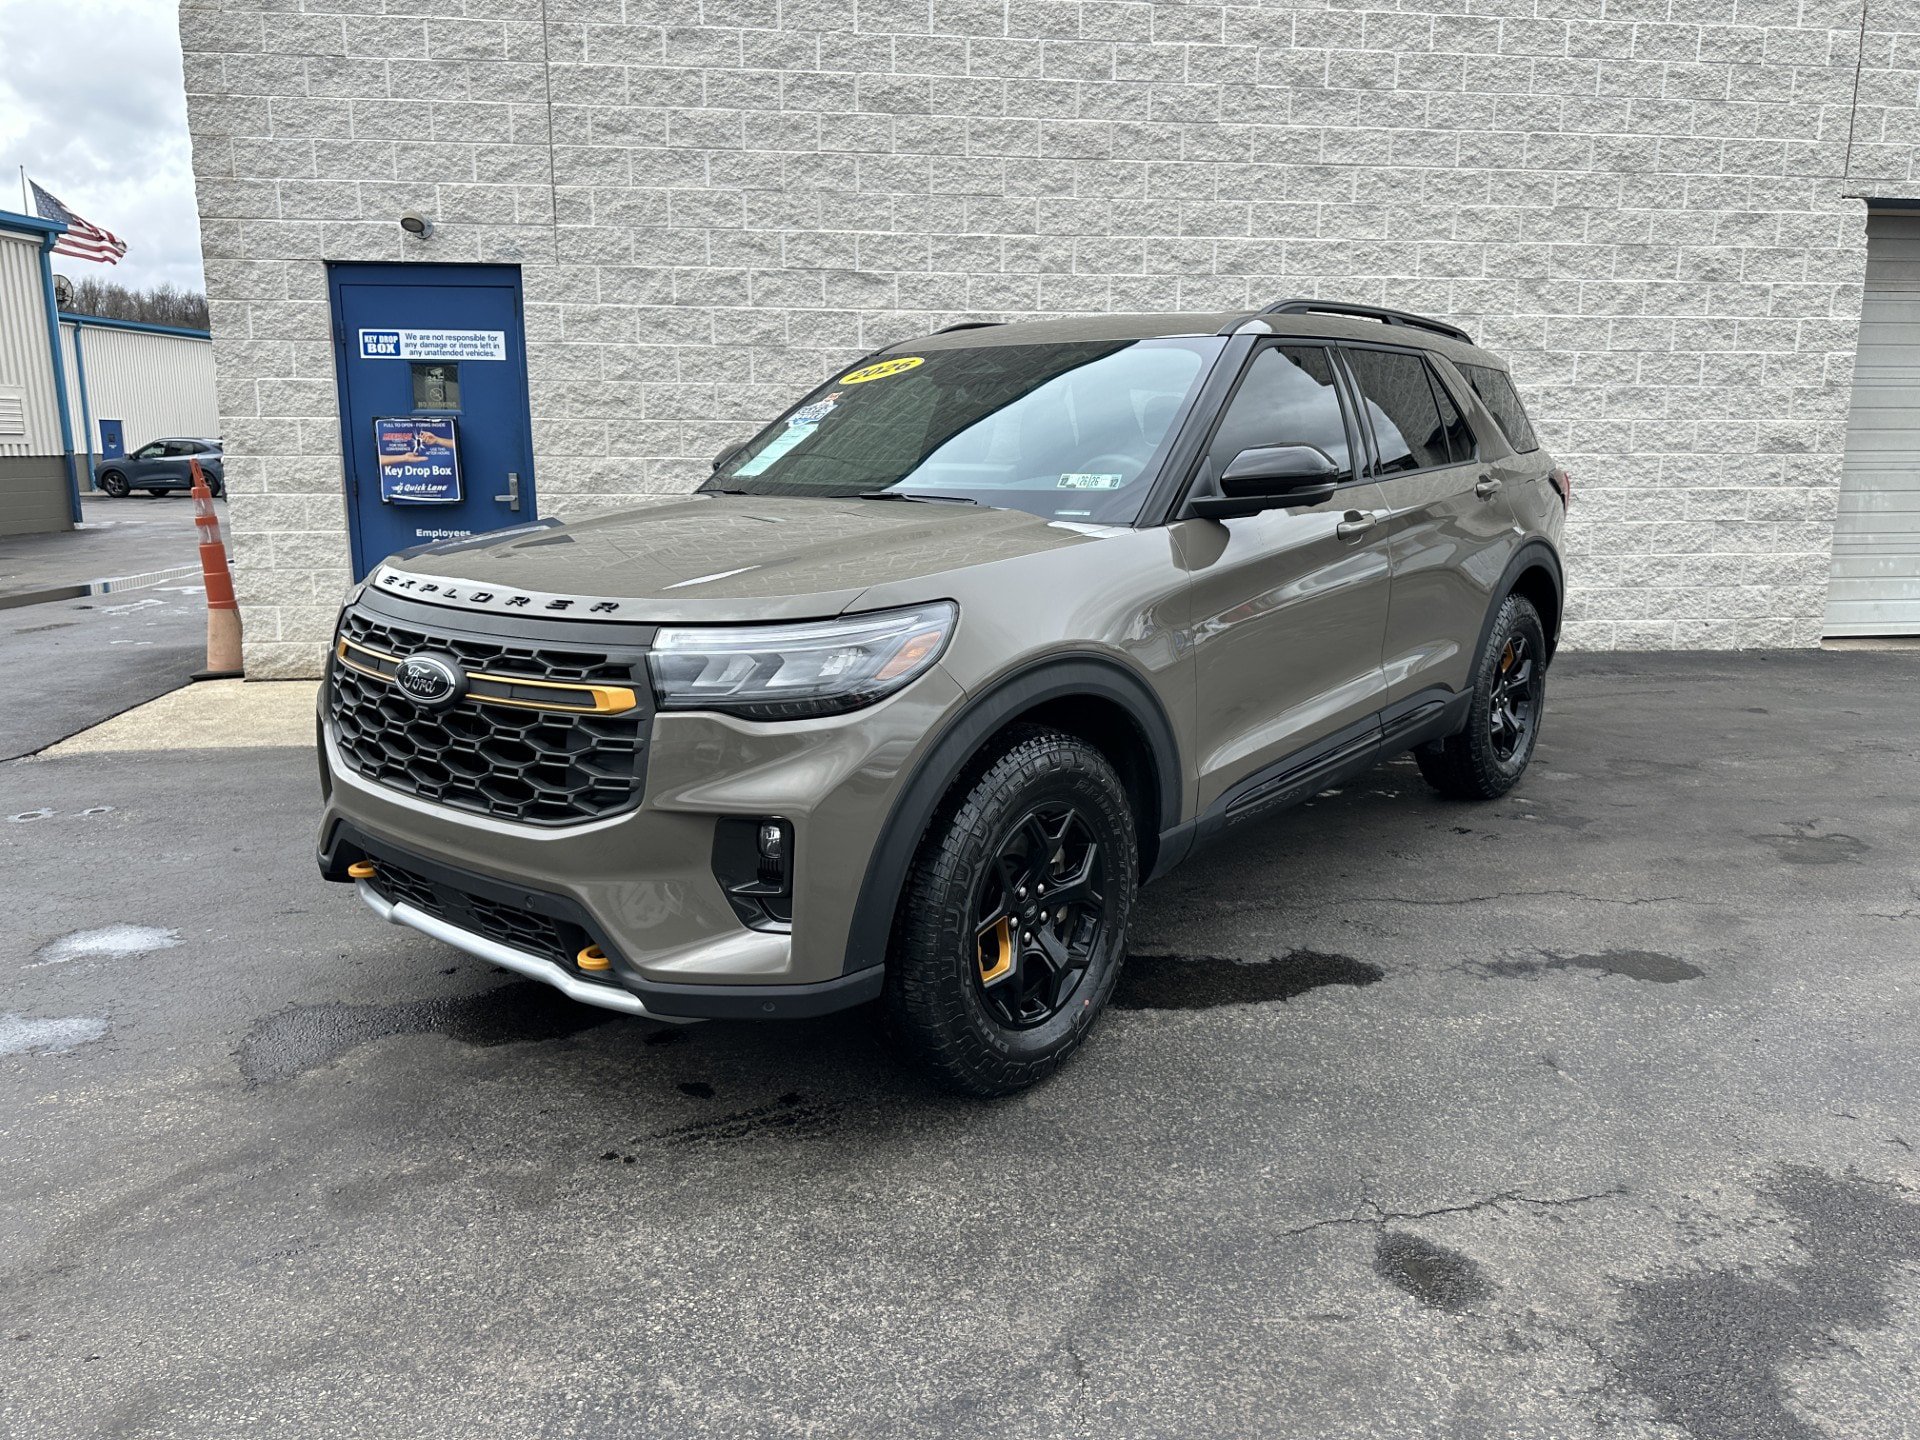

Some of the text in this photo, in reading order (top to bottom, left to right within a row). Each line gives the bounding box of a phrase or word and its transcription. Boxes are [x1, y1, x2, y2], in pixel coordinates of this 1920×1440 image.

[364, 335, 399, 344] KEY DROP
[404, 333, 417, 341] We
[432, 333, 444, 341] not
[445, 334, 486, 343] responsible
[487, 334, 498, 342] for
[367, 343, 396, 354] BOX
[419, 341, 447, 349] damage
[424, 348, 464, 357] unattended
[466, 349, 497, 357] vehicles.
[384, 465, 452, 478] Key Drop Box
[404, 483, 448, 492] Quick Lane
[416, 528, 471, 538] Employees
[383, 575, 620, 614] EXPLORER
[404, 665, 437, 694] Ford
